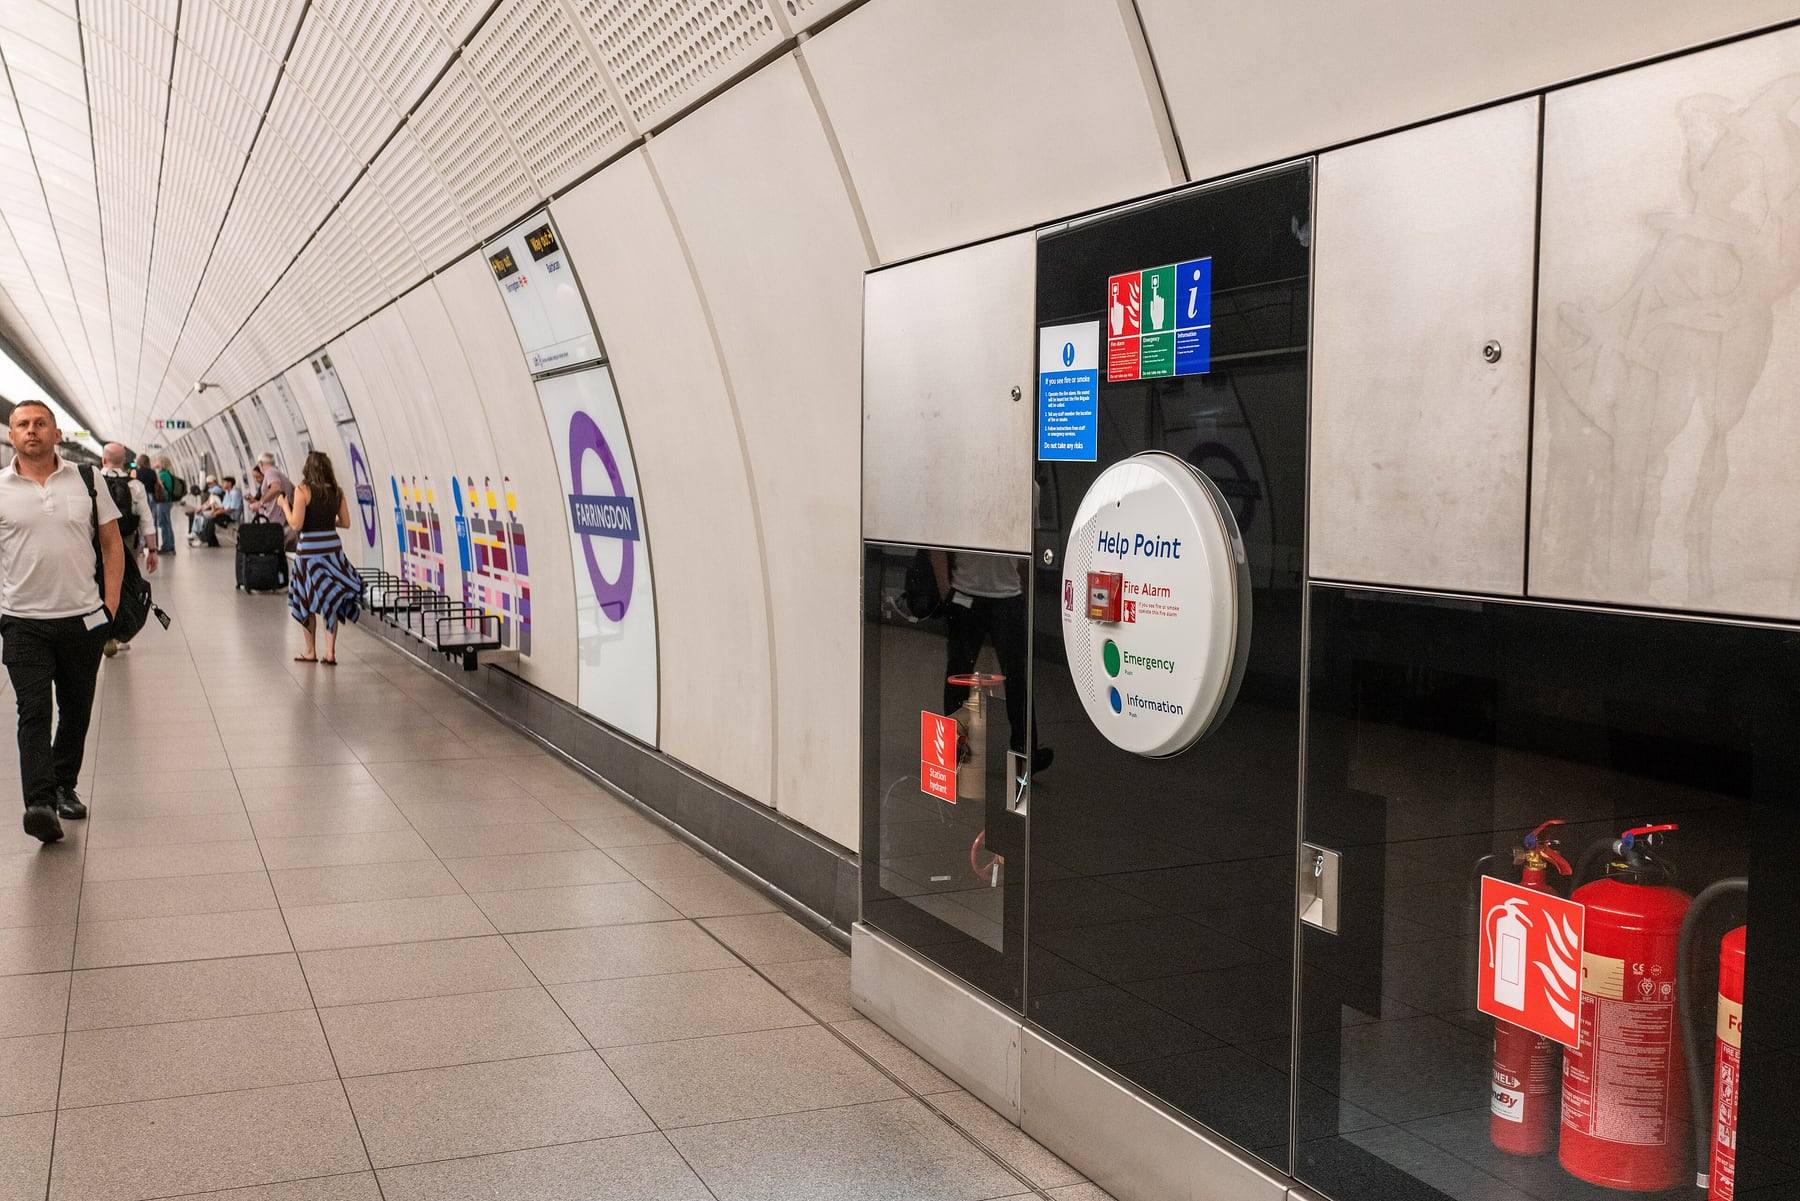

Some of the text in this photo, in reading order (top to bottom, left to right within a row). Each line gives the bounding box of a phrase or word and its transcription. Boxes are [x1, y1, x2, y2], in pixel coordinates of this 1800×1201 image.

[530, 232, 551, 253] Way out
[495, 255, 513, 272] Way out
[575, 503, 632, 532] FARRINGDON
[1098, 530, 1182, 560] Help Point
[1124, 581, 1170, 598] Fire Alarm
[1123, 651, 1175, 674] Emergency
[1126, 693, 1184, 715] Information
[929, 768, 946, 782] Station
[929, 780, 947, 794] hydrant
